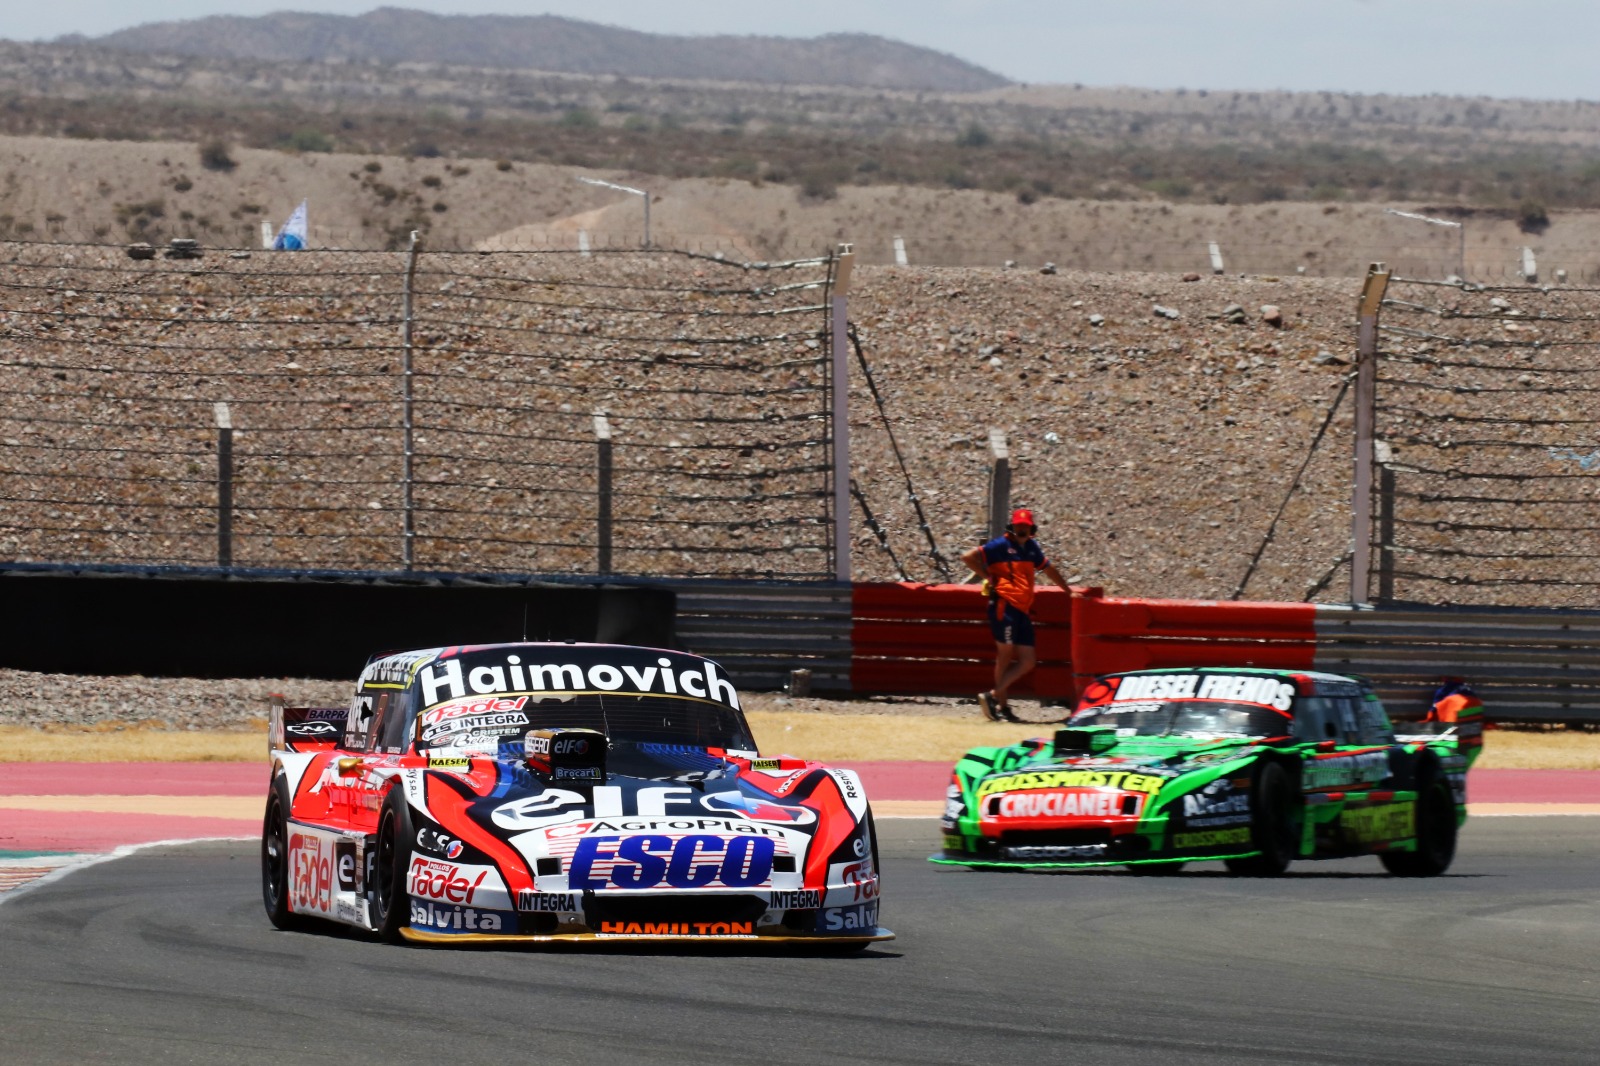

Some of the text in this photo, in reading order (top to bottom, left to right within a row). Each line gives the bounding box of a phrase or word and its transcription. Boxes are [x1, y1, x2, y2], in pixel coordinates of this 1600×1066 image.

[420, 654, 741, 711] Haimovich
[1114, 675, 1200, 701] DIESEL
[1198, 675, 1296, 712] FRENOS
[460, 714, 527, 729] INTEGRA
[976, 771, 1166, 796] CROSSMASTER
[999, 792, 1122, 818] CRUCIANEL
[568, 834, 776, 889] ESCO
[410, 857, 488, 904] Fadel
[518, 892, 577, 912] INTEGRA
[769, 890, 820, 909] INTEGRA
[410, 900, 502, 931] Salvita
[601, 921, 753, 935] HAMILTON
